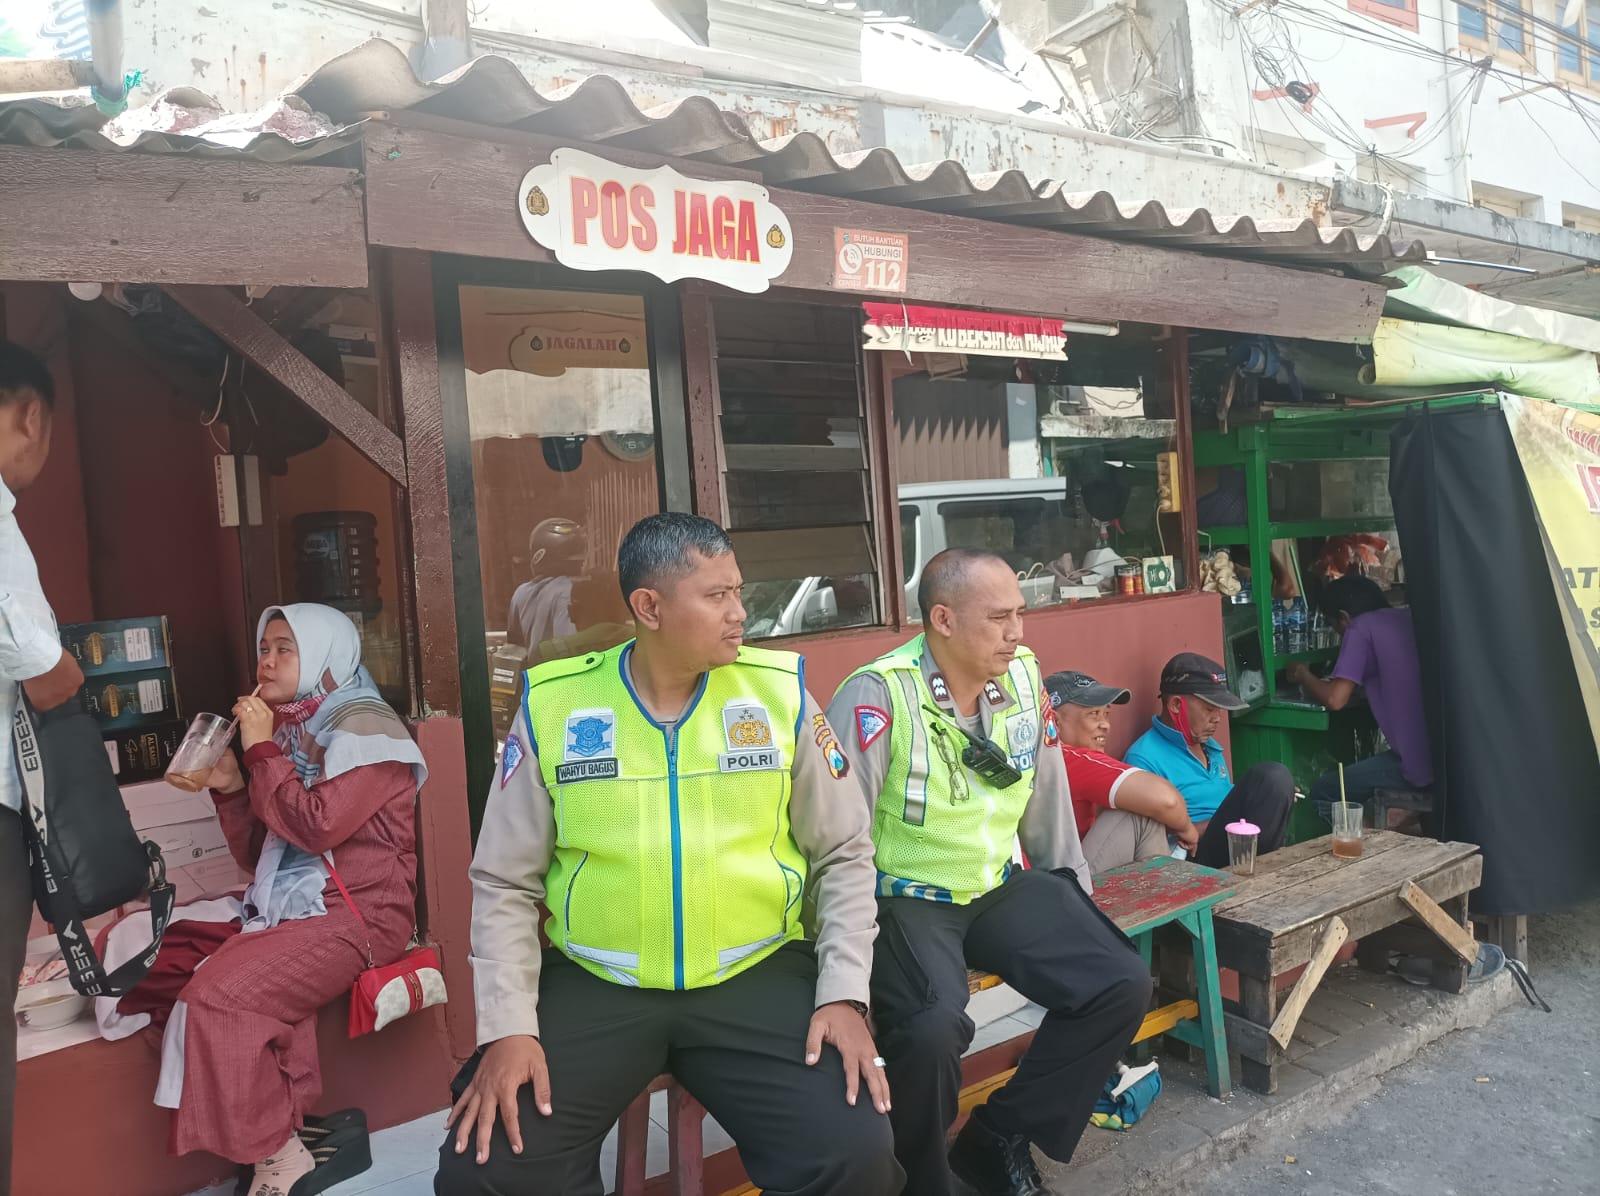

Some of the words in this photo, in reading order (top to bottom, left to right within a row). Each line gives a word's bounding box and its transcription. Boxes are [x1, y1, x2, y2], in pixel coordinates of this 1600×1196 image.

[570, 176, 658, 252] POS
[672, 189, 761, 264] JAGA
[853, 234, 875, 242] BUTUH
[875, 236, 904, 246] BANTUAN
[864, 247, 901, 258] HUBUNGI
[865, 261, 901, 289] 112
[545, 336, 618, 351] JAGALAH
[726, 754, 773, 768] POLRI
[560, 763, 586, 779] WAHYU
[588, 760, 614, 775] BAGUS
